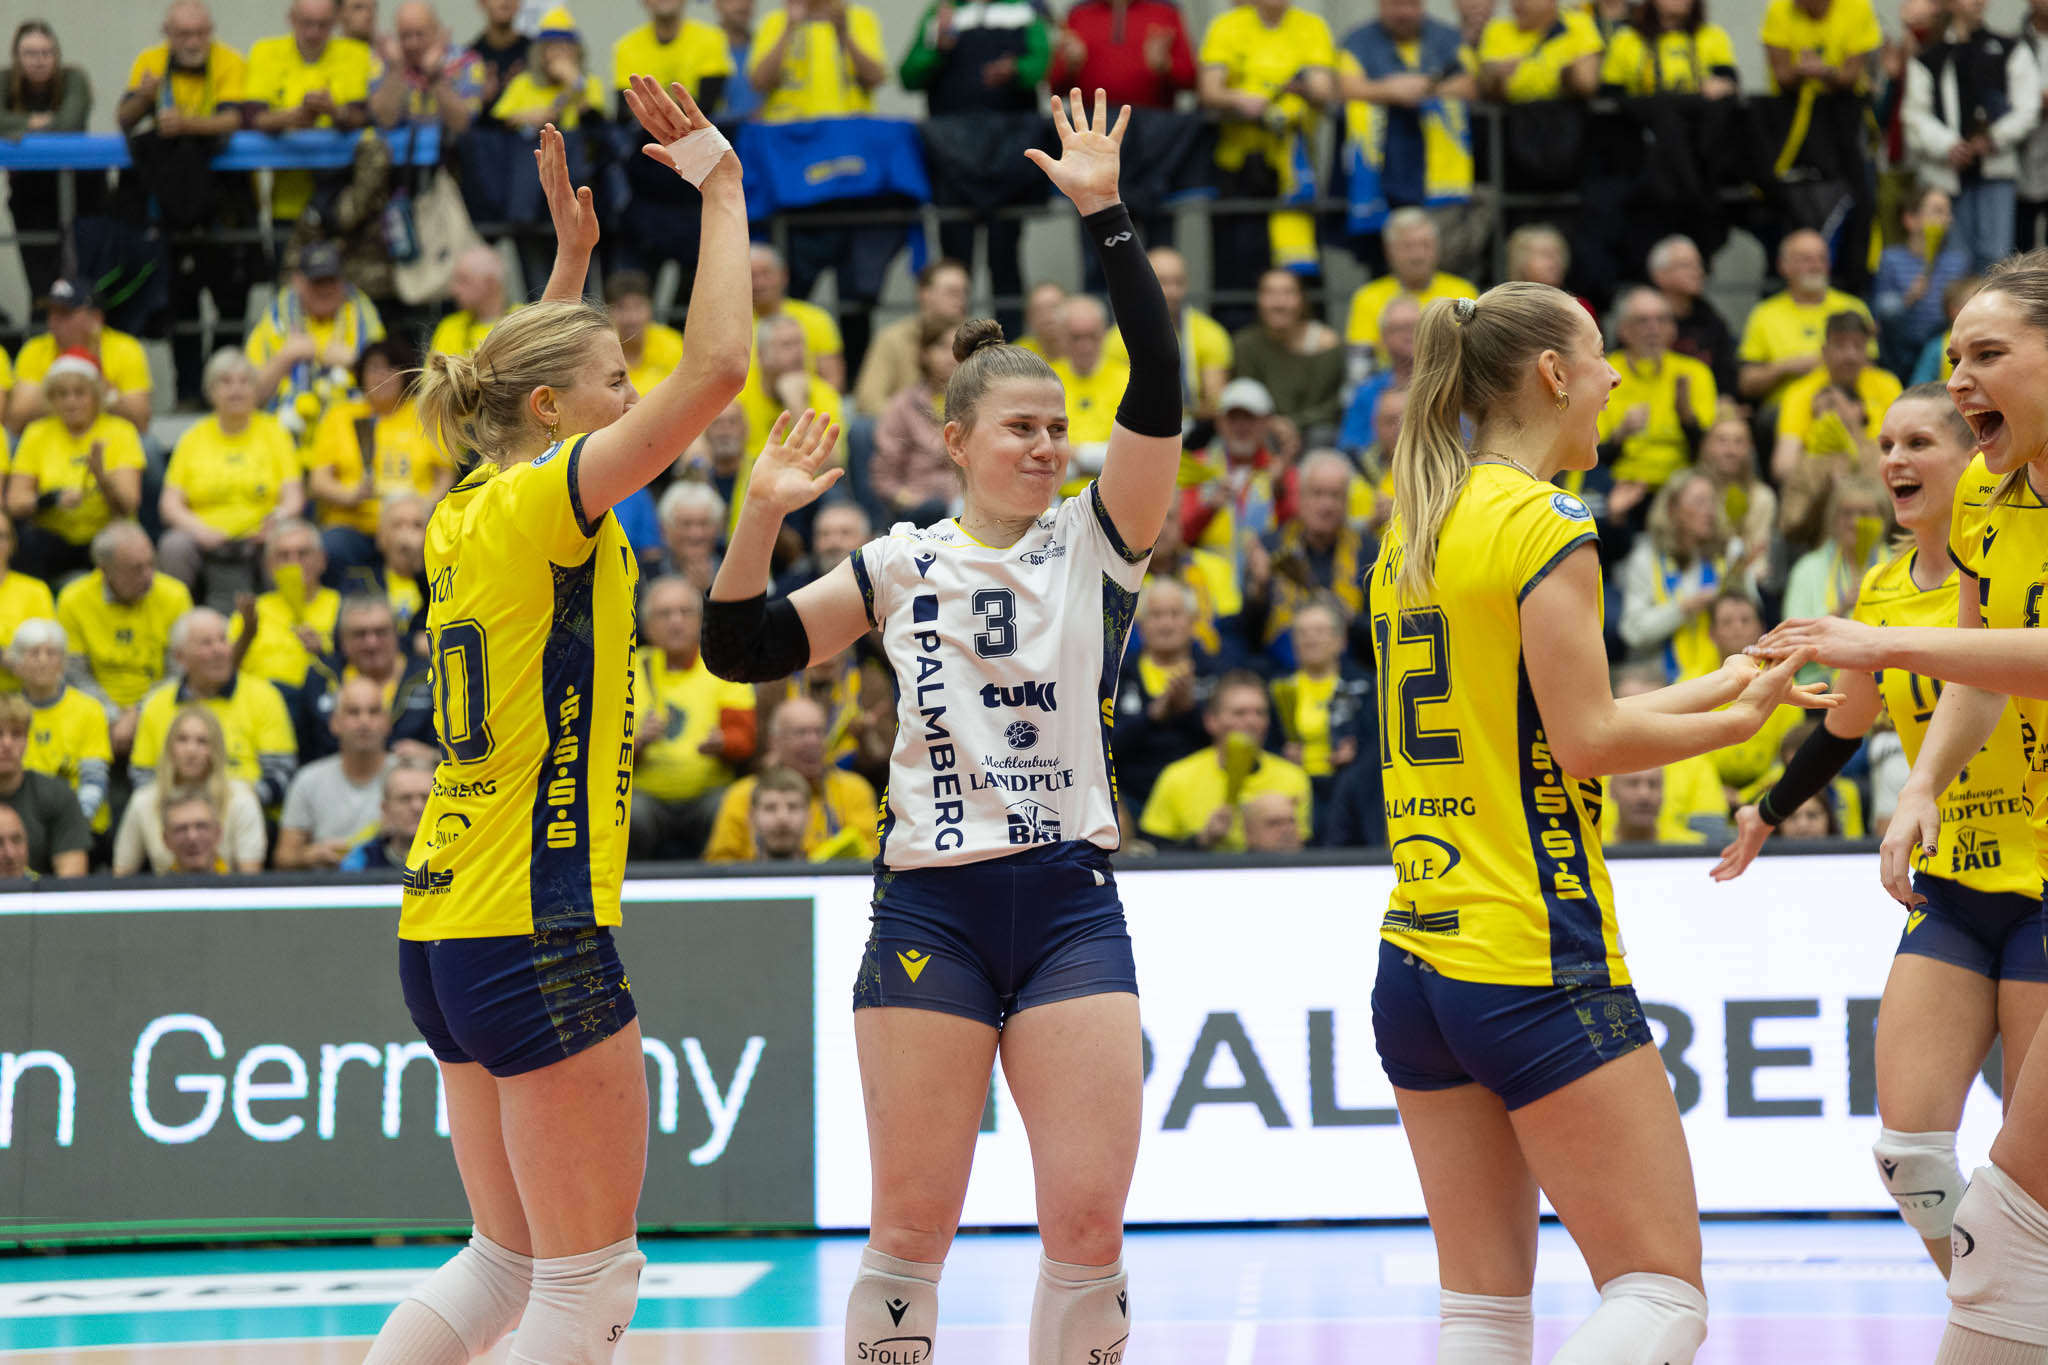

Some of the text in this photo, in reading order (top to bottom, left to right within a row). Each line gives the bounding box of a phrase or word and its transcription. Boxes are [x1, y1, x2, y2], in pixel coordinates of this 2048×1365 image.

[972, 588, 1017, 659] 3
[1374, 605, 1464, 770] 12
[913, 629, 964, 852] PALMBERG
